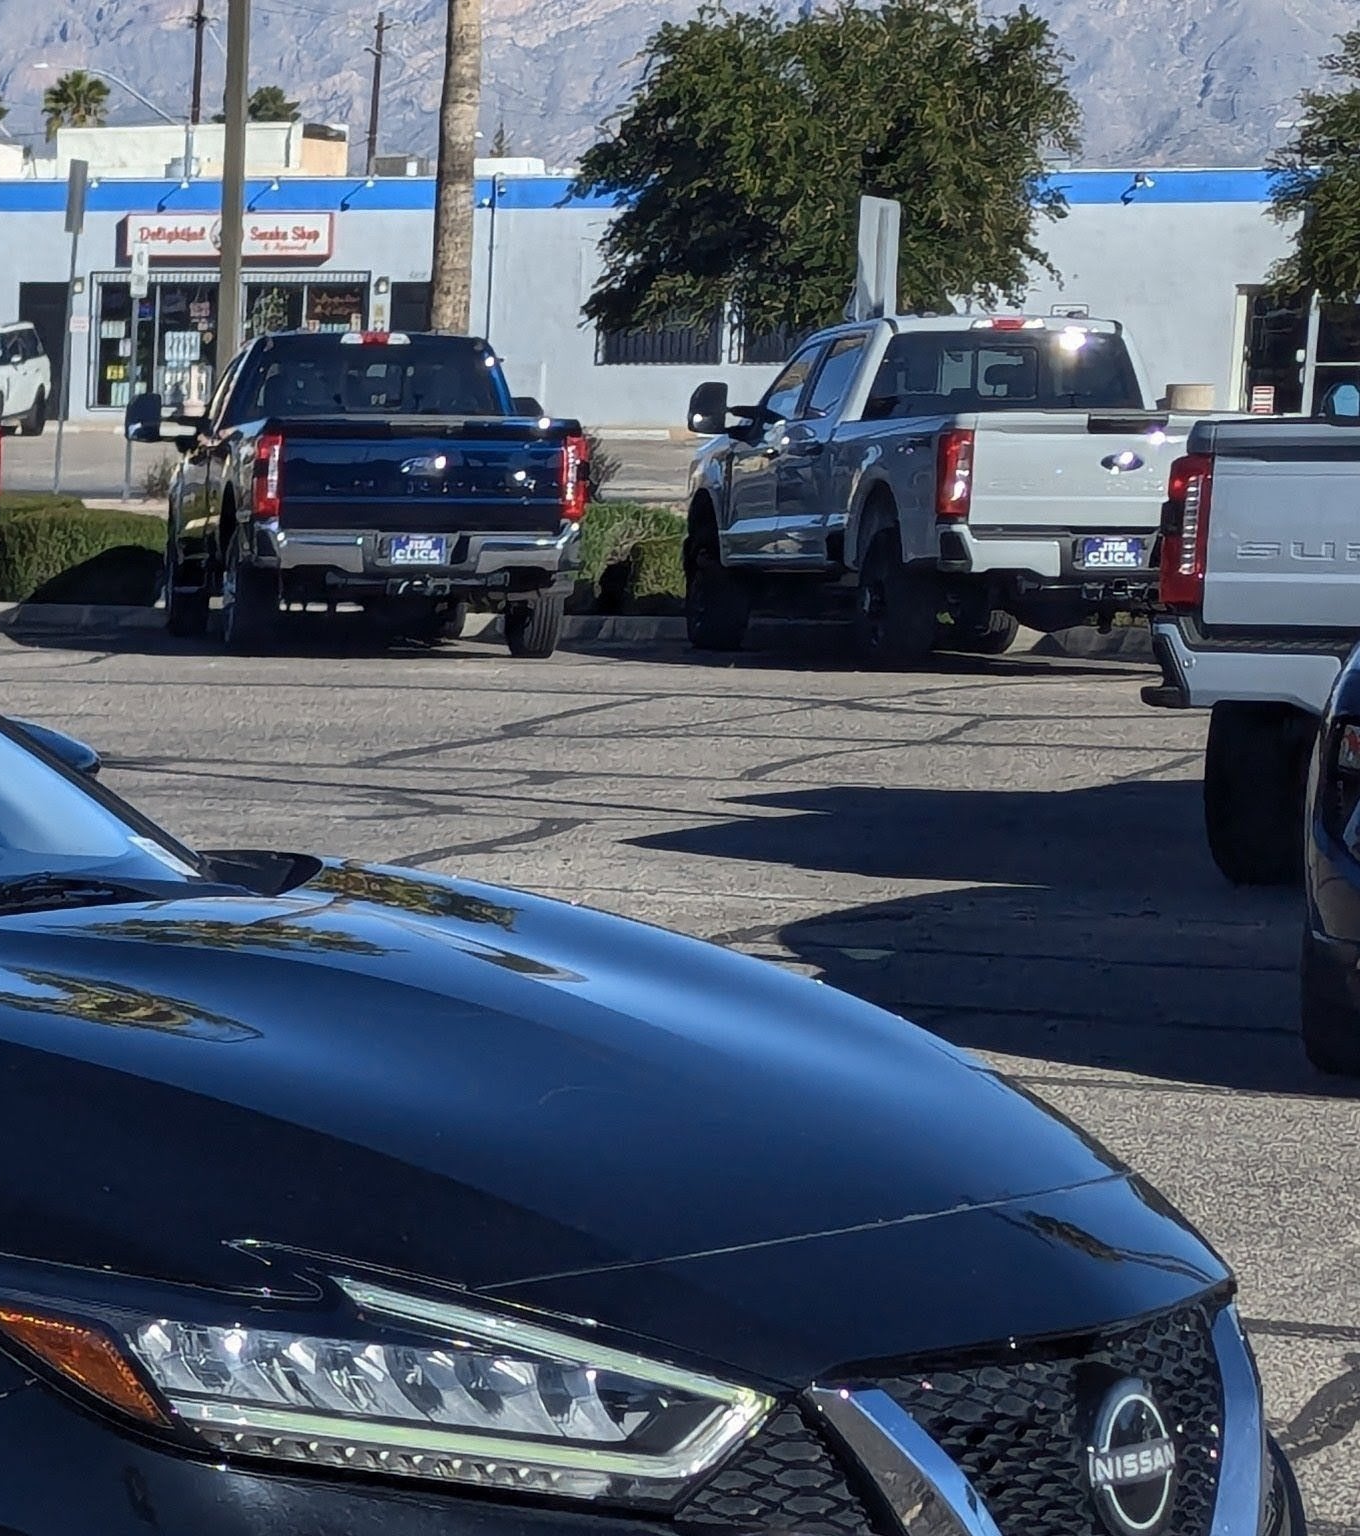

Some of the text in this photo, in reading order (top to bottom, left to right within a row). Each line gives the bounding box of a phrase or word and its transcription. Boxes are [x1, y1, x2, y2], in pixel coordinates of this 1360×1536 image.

[249, 226, 289, 240] Smoke
[291, 225, 321, 243] Shop
[395, 549, 441, 562] CLICK
[1087, 551, 1137, 564] CLICK
[1095, 1442, 1177, 1481] NISSAN
